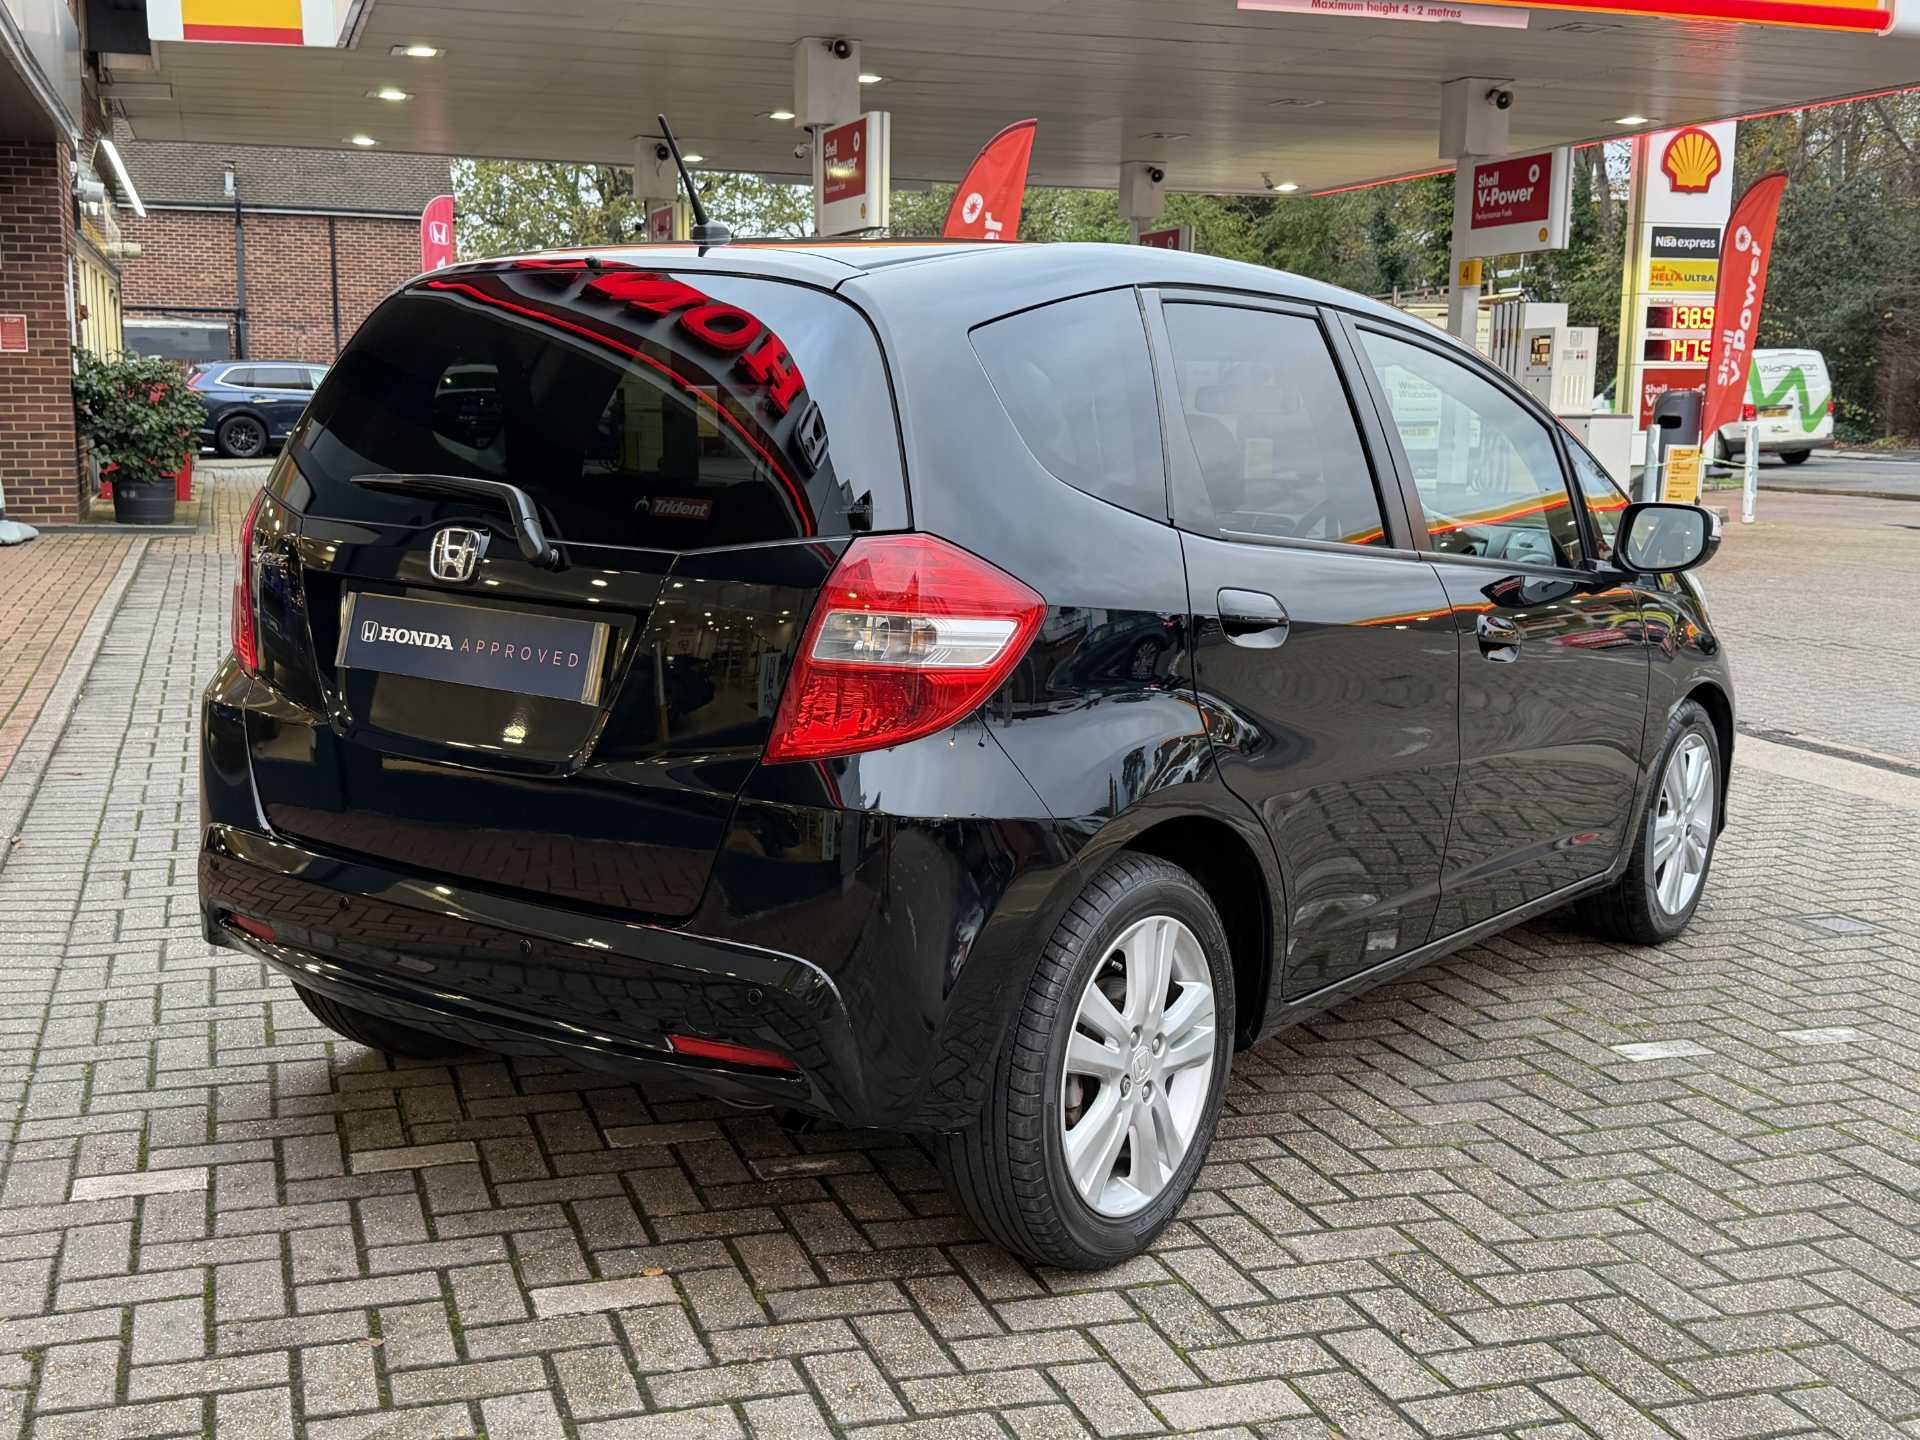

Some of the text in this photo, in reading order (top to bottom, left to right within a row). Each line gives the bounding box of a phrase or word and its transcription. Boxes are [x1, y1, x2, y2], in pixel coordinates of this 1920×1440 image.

[1311, 0, 1363, 11] Maximum
[1366, 1, 1399, 15] height
[1427, 7, 1462, 18] metres
[1478, 171, 1499, 188] Shell
[1478, 187, 1534, 208] V-Power
[1655, 235, 1716, 250] Nisa express
[1462, 265, 1470, 281] 4
[1651, 272, 1714, 282] HELIX ULTRA
[1672, 307, 1715, 328] 138.9
[1717, 330, 1735, 387] Shell
[1645, 384, 1668, 394] Shell
[655, 500, 708, 517] Trident
[379, 626, 580, 668] HONDA APPROVED
